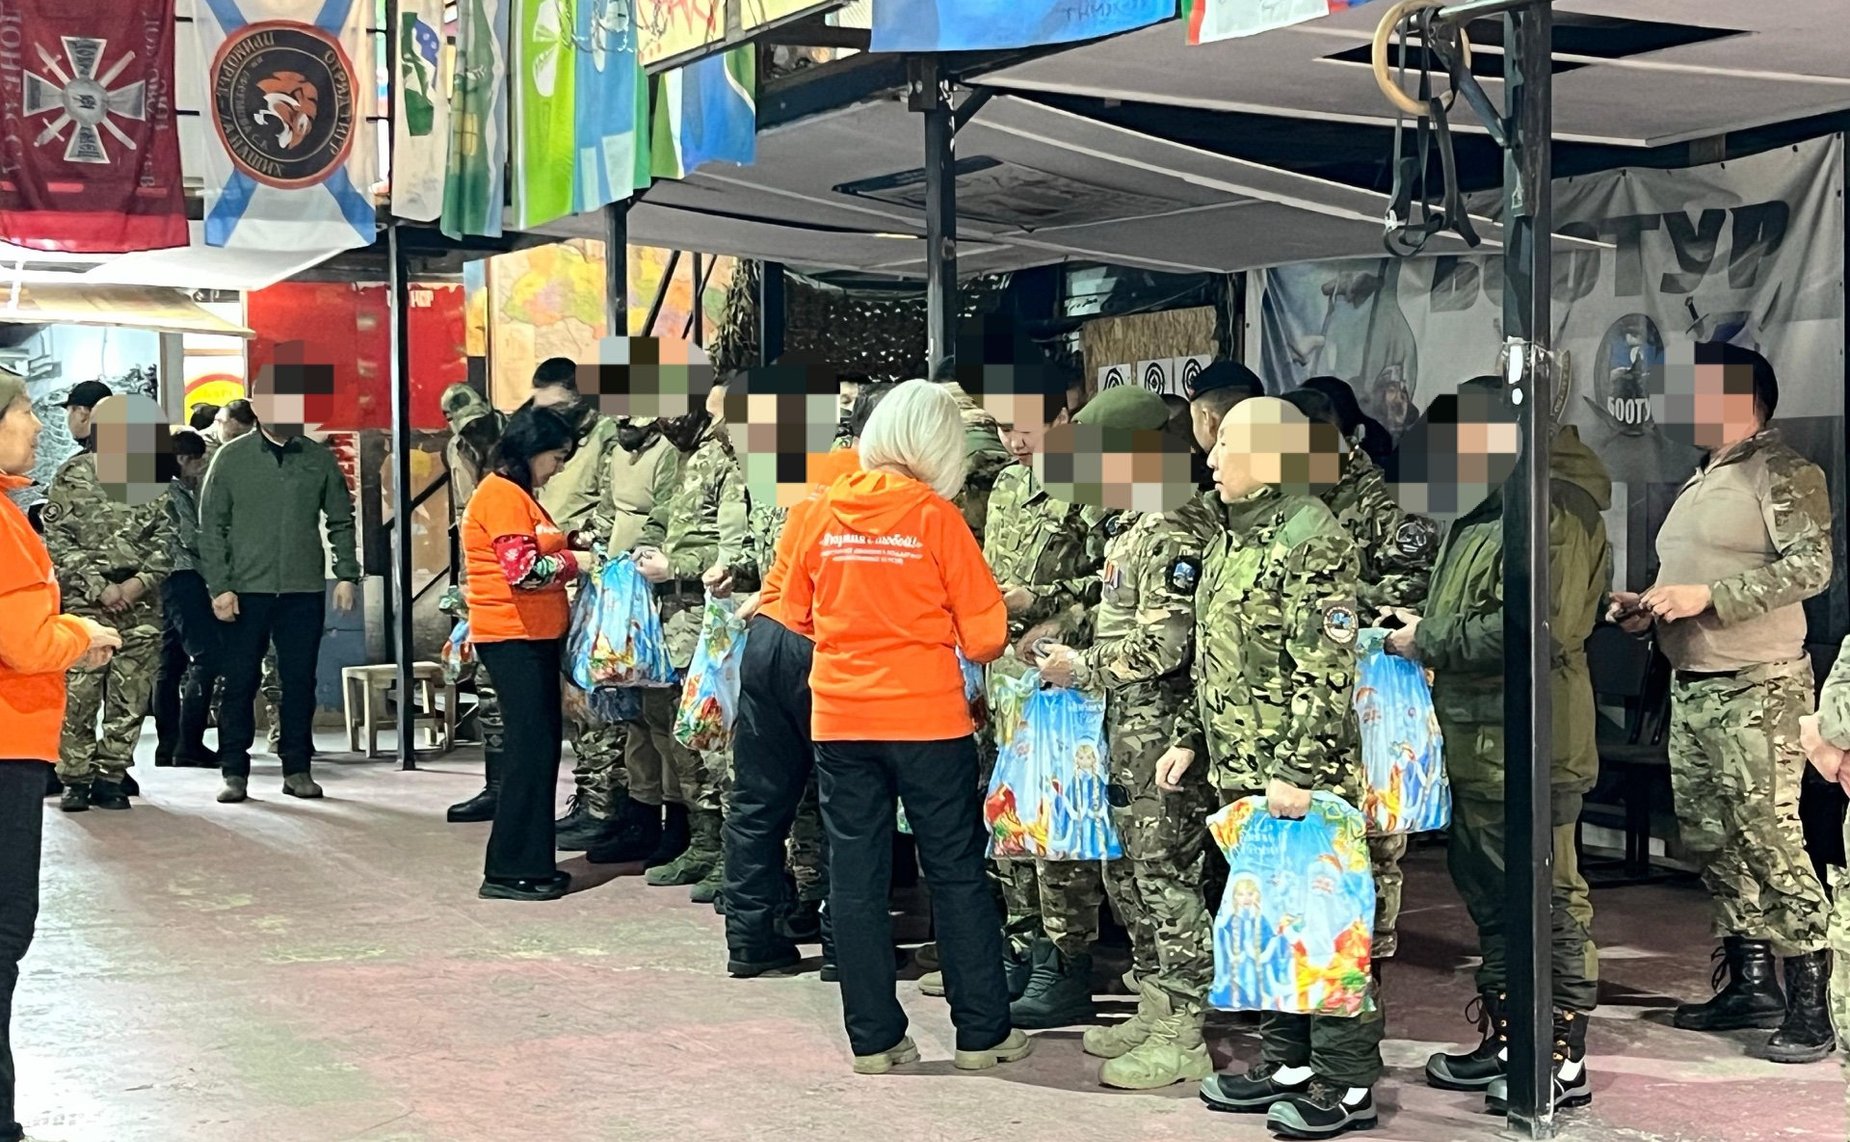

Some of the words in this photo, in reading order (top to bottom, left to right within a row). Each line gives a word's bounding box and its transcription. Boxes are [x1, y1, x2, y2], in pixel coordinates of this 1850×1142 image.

[323, 49, 350, 107] ОТРЯД
[329, 112, 351, 155] ТИГР
[1607, 396, 1651, 425] БООТУ
